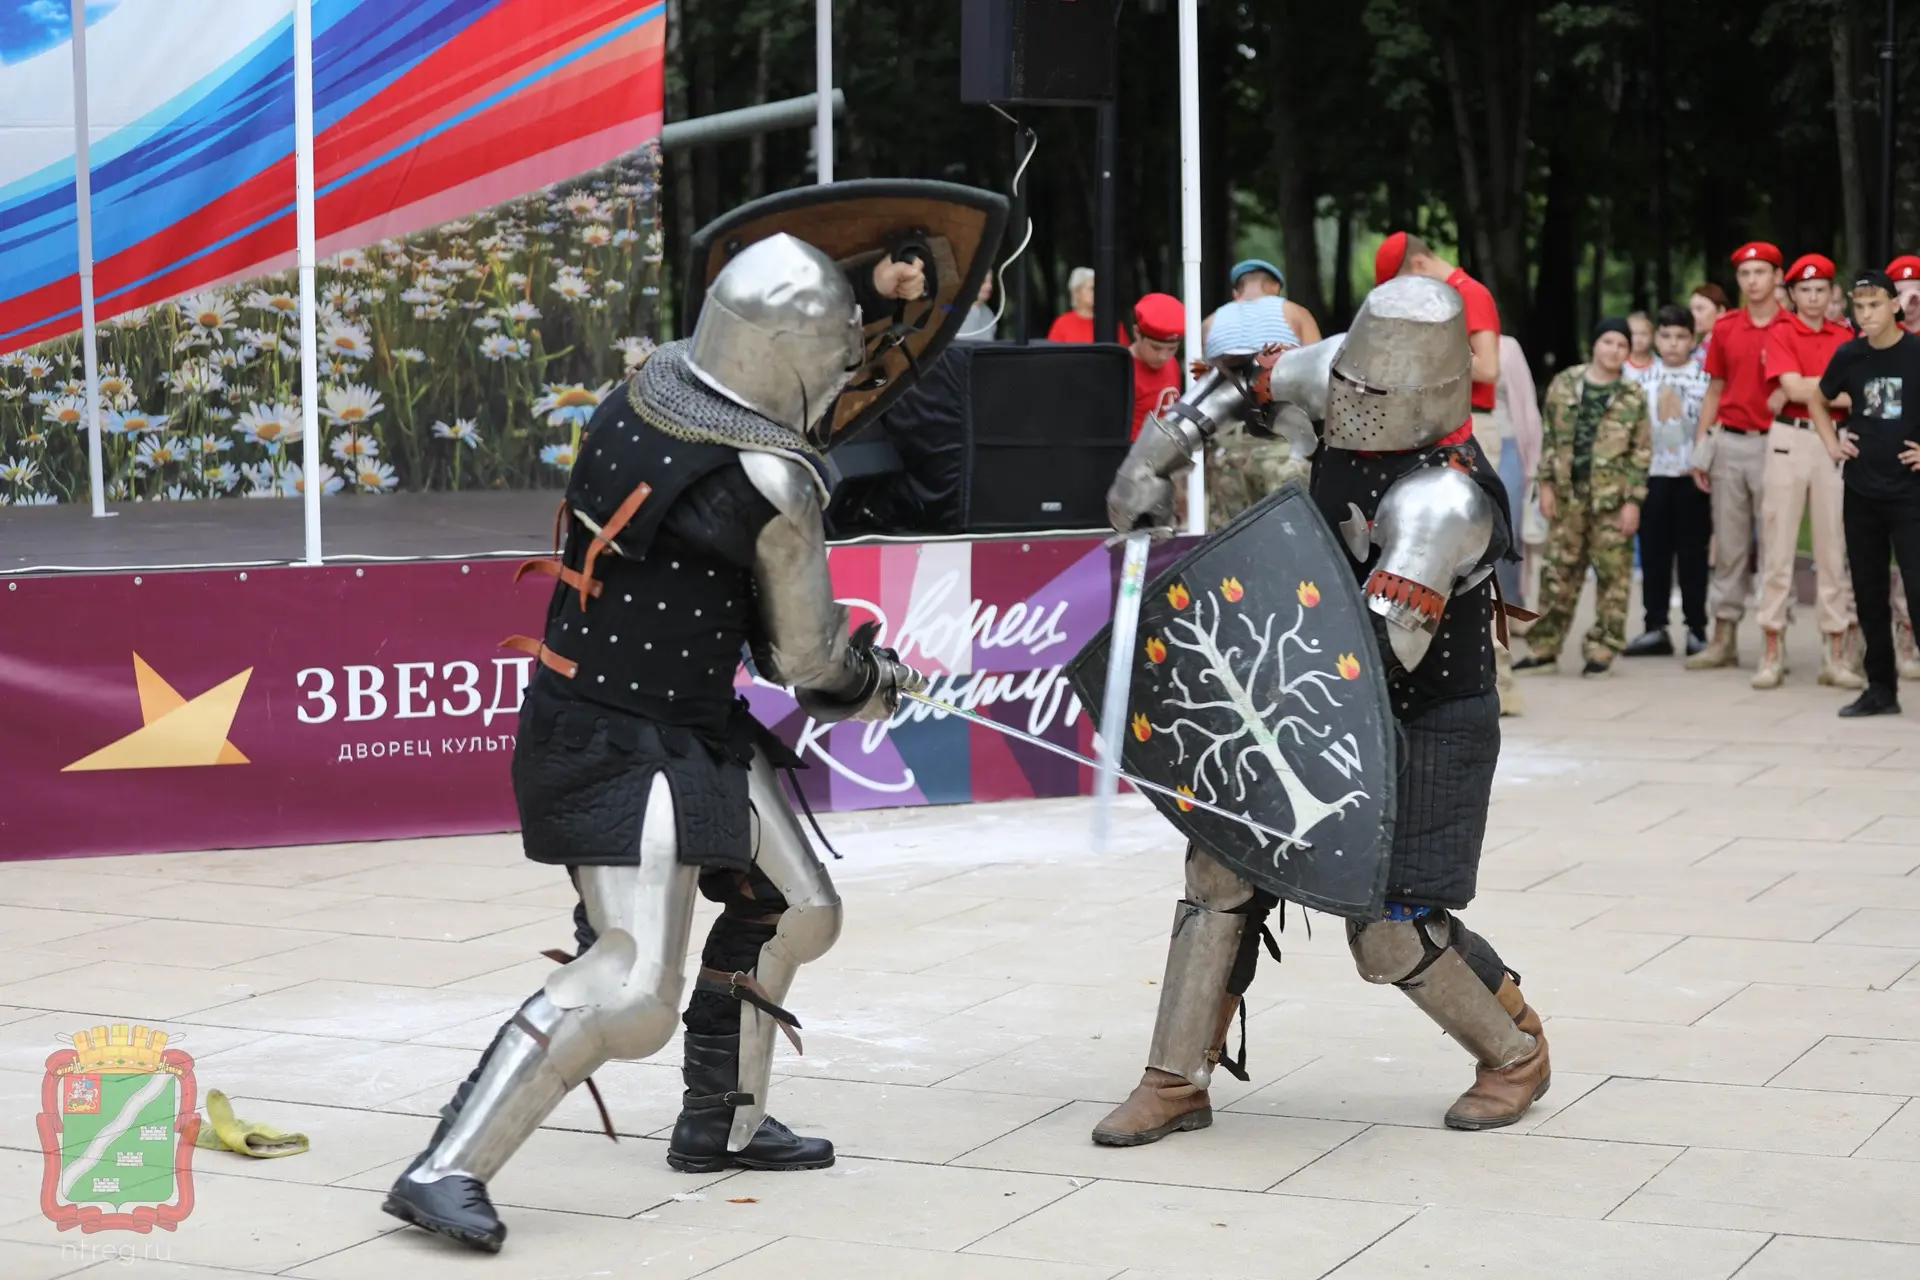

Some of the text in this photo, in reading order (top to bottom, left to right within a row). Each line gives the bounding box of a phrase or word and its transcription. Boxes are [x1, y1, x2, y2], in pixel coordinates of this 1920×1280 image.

[296, 656, 535, 727] ЗВЕЗД
[338, 734, 517, 762] ДВОРЕЦ КУЛЬТ
[1319, 732, 1363, 780] W
